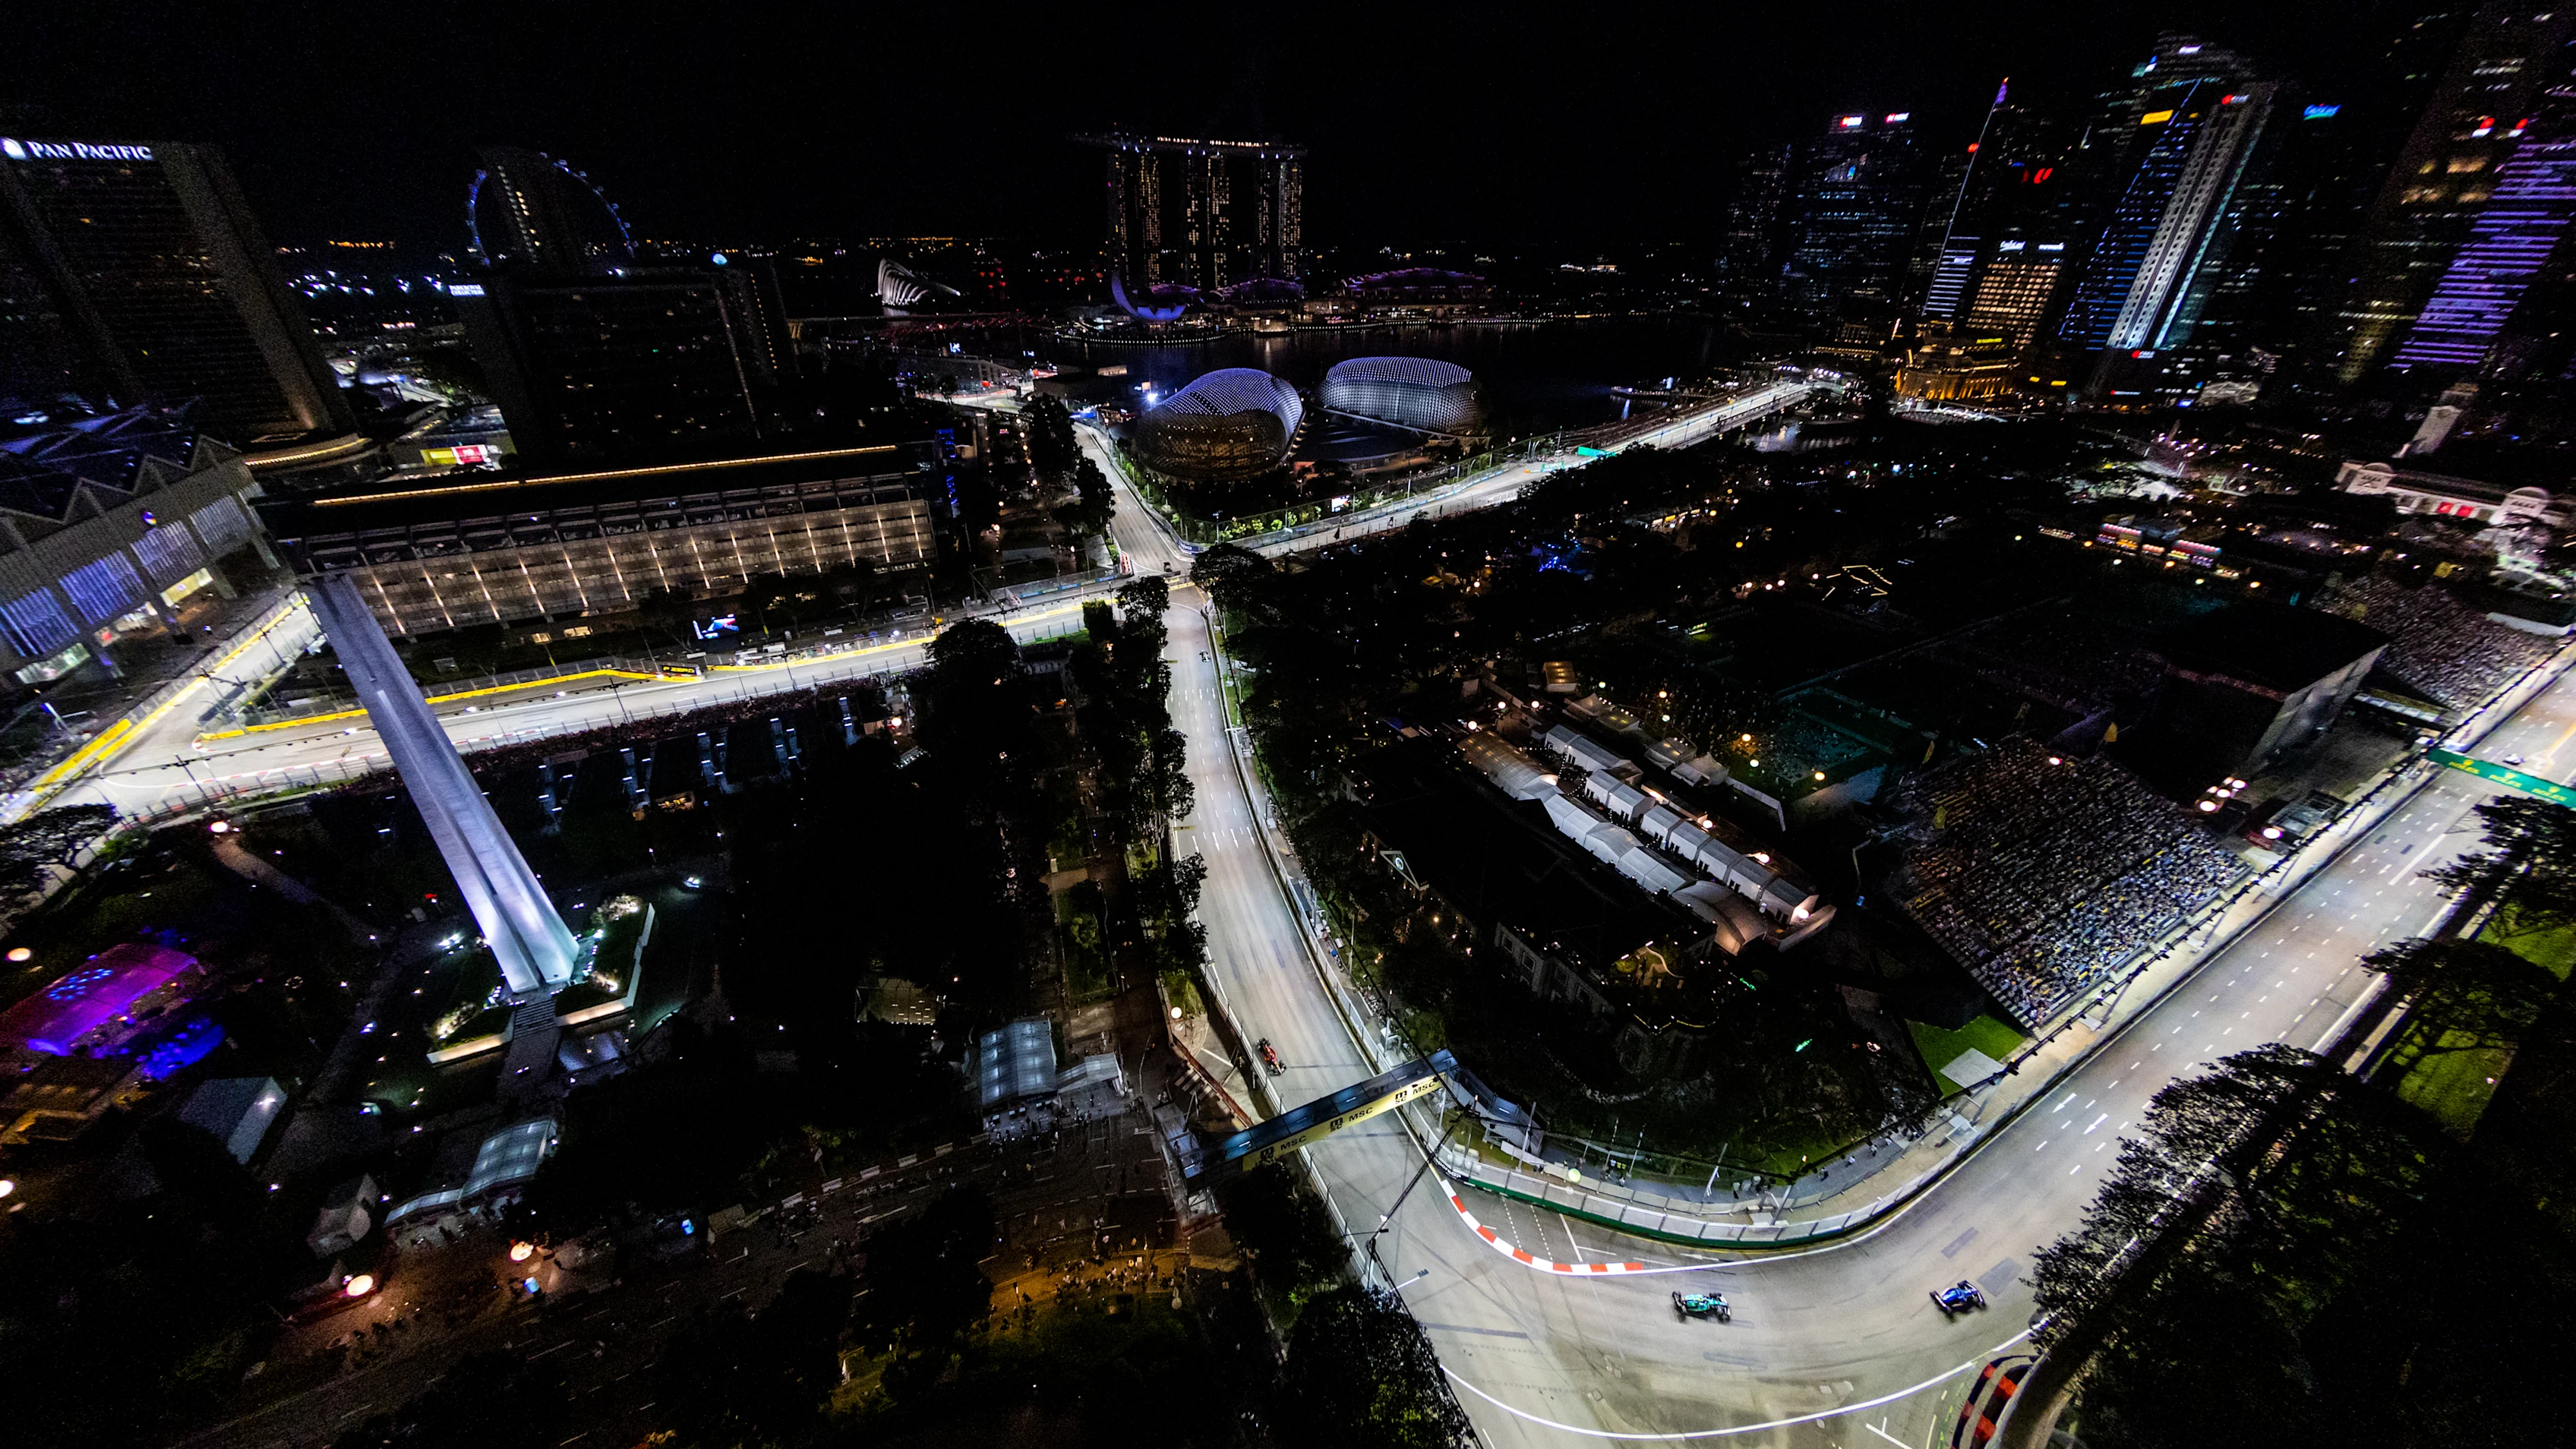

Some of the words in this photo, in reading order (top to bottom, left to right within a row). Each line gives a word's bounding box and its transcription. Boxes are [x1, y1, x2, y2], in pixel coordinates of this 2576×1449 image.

[24, 140, 75, 159] PAN
[71, 141, 153, 161] PACIFIC
[1413, 1081, 1435, 1095] MSC
[1349, 1107, 1373, 1122] MSC
[1280, 1135, 1306, 1151] MSC
